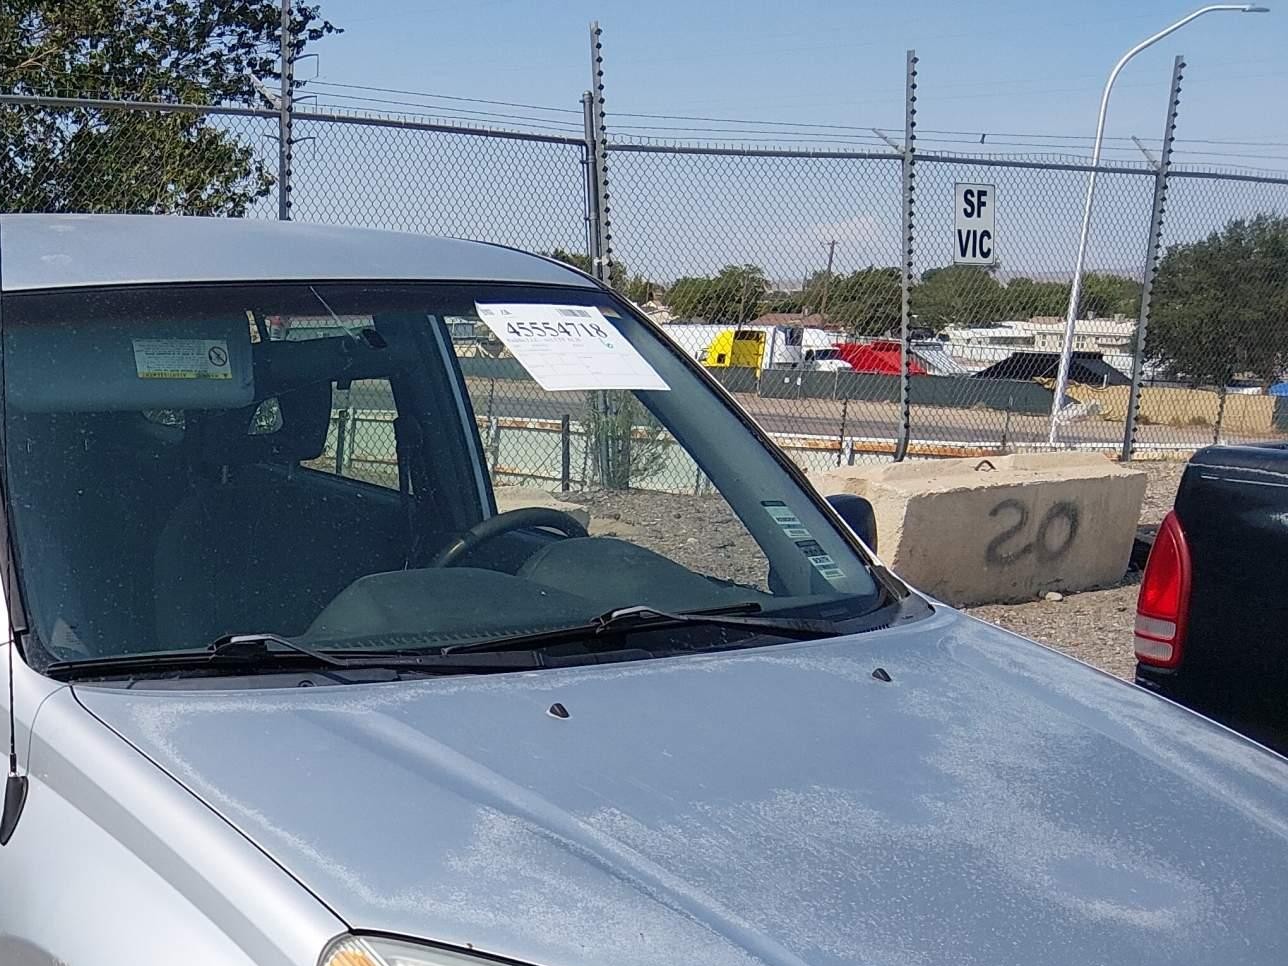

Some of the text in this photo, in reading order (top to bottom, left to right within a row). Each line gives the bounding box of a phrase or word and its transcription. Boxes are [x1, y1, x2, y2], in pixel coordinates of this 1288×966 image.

[963, 188, 988, 219] SF
[957, 228, 992, 259] VIC
[507, 322, 609, 339] 45554718
[986, 499, 1080, 566] 20
